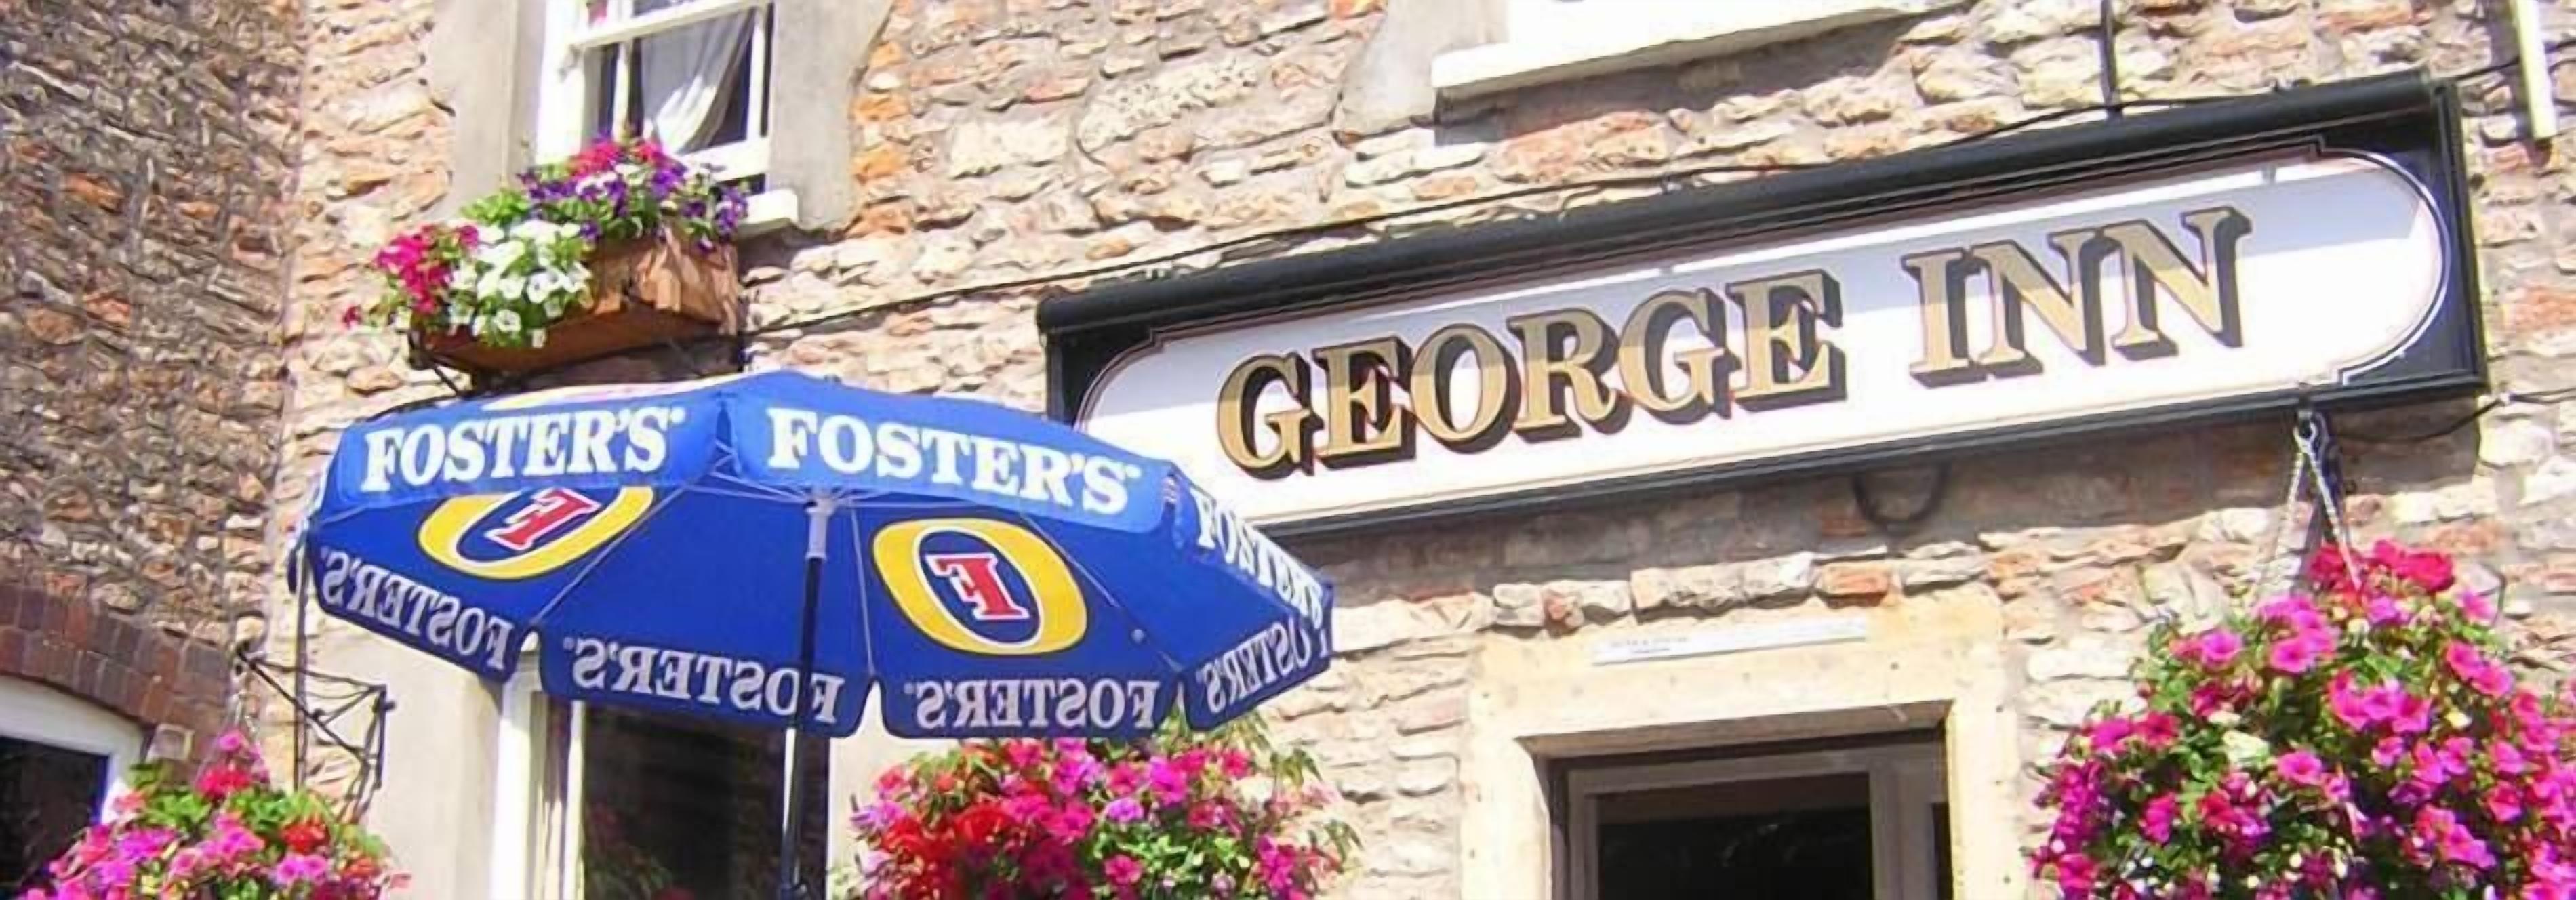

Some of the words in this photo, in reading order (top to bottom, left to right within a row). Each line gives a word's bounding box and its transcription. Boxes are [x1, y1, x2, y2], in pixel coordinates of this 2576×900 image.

[1217, 270, 1847, 480] GEORGE
[1900, 205, 2252, 388] INN
[361, 409, 672, 492] FOSTER'S
[766, 408, 1130, 515] FOSTER'S
